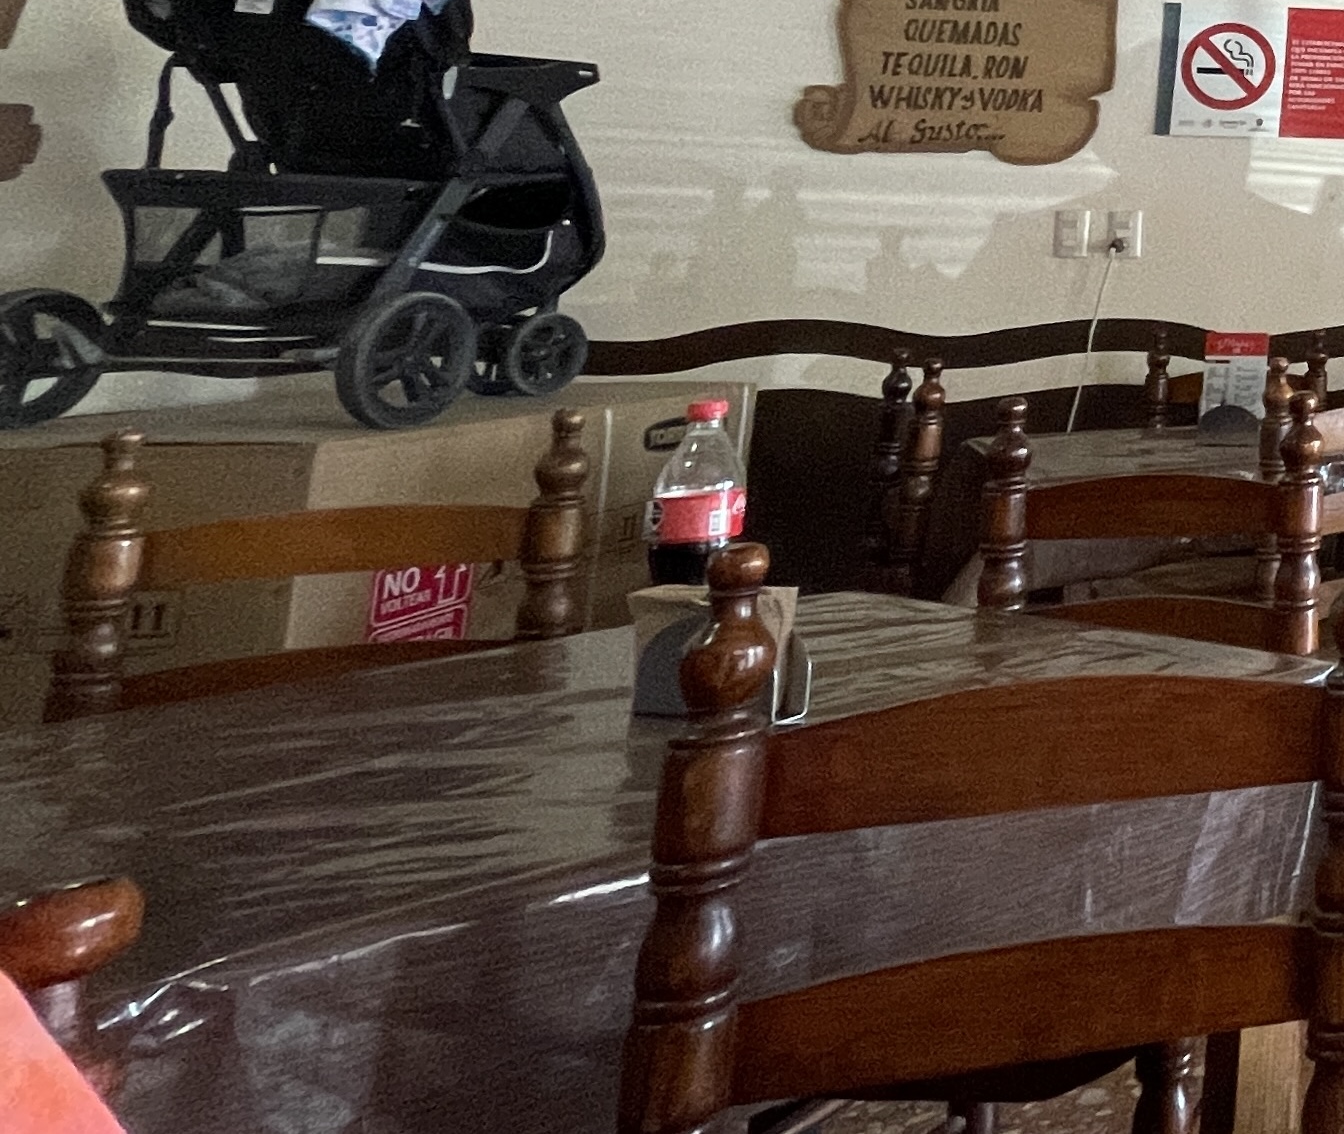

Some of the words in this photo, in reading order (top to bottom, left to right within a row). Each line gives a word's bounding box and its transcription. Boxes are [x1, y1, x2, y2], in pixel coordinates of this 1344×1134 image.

[903, 18, 1022, 47] QUEMADAS
[981, 55, 1029, 80] RON
[868, 84, 963, 111] WHISKY
[978, 86, 1044, 113] VODKA
[383, 566, 421, 599] NO
